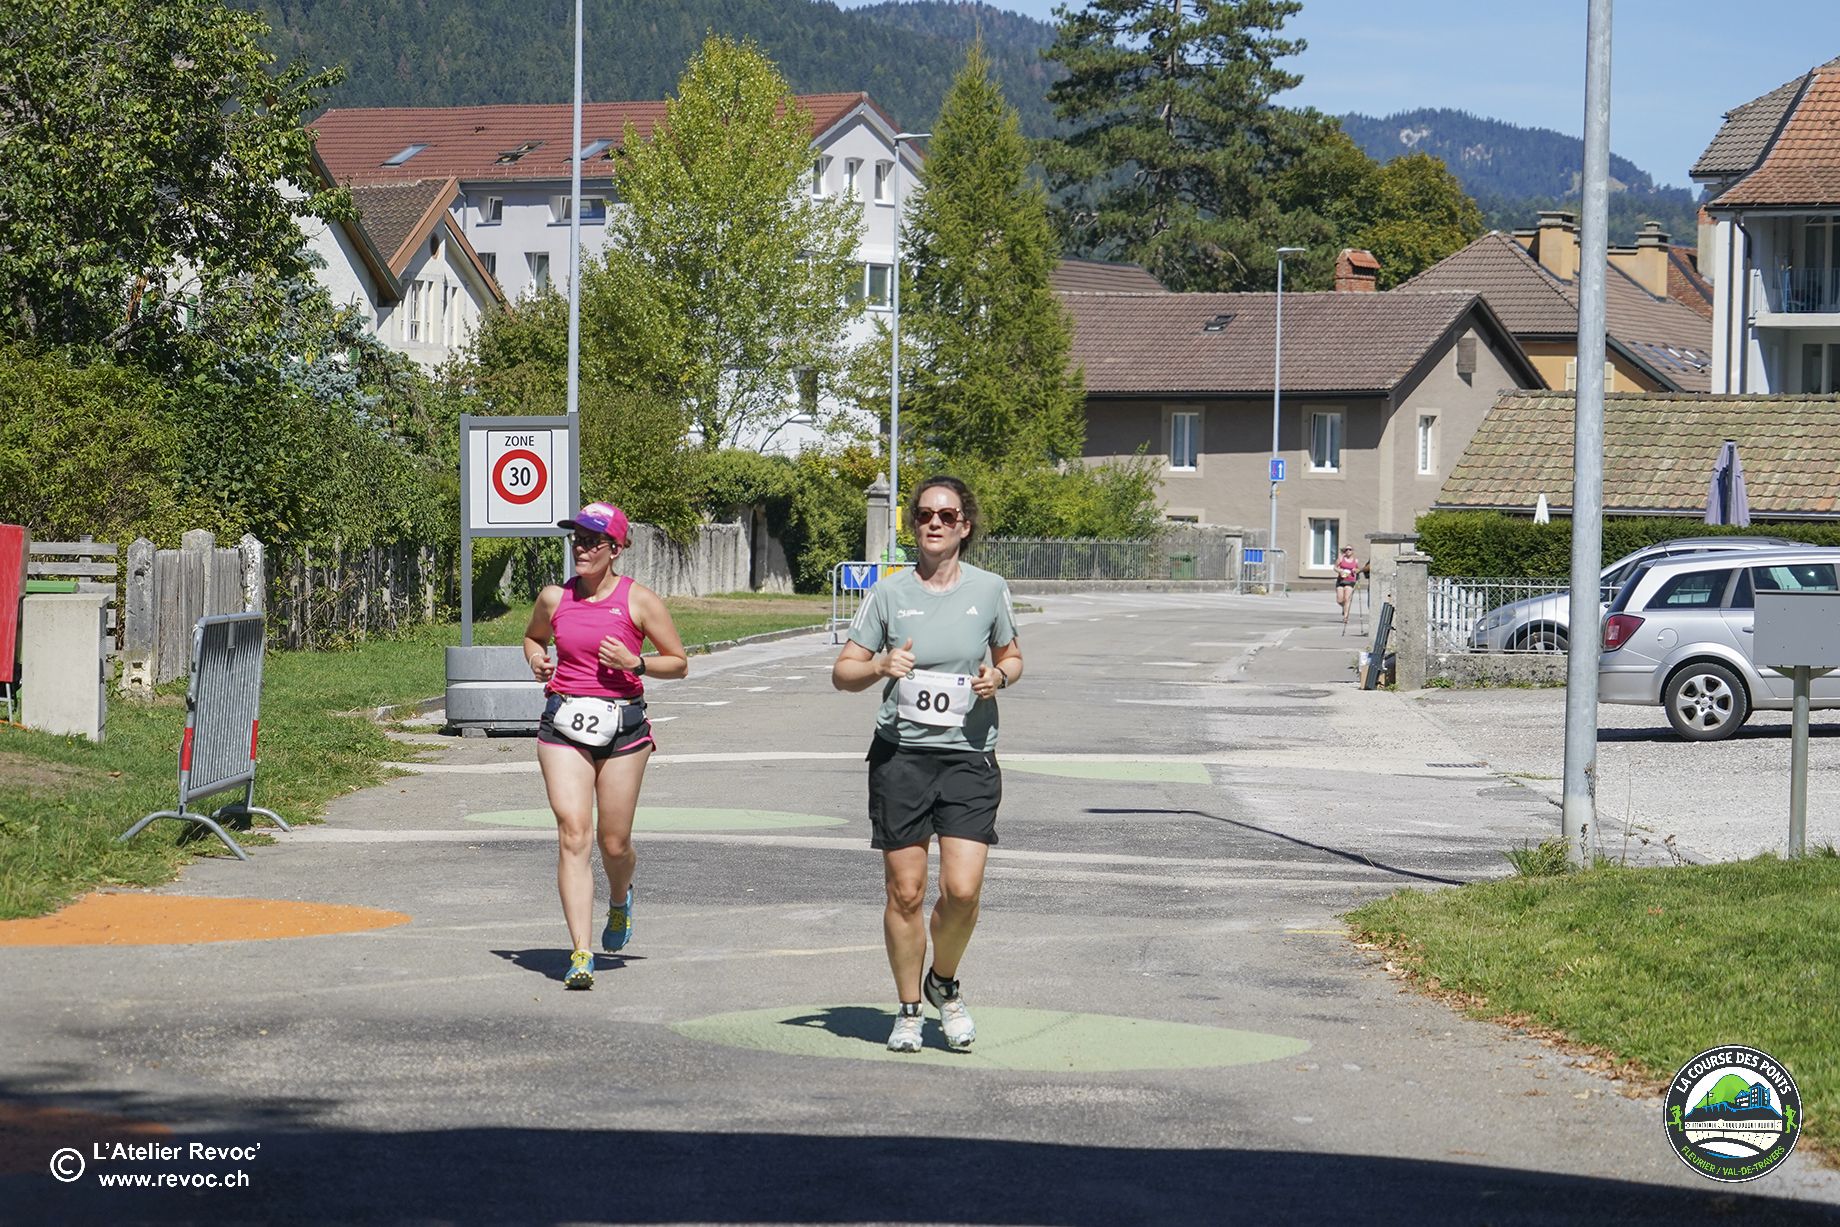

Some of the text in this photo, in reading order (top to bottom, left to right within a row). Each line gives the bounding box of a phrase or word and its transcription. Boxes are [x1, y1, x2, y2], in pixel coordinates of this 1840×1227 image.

[505, 435, 535, 447] ZONE
[509, 466, 531, 487] 30
[916, 690, 950, 713] 80
[571, 712, 599, 735] 82
